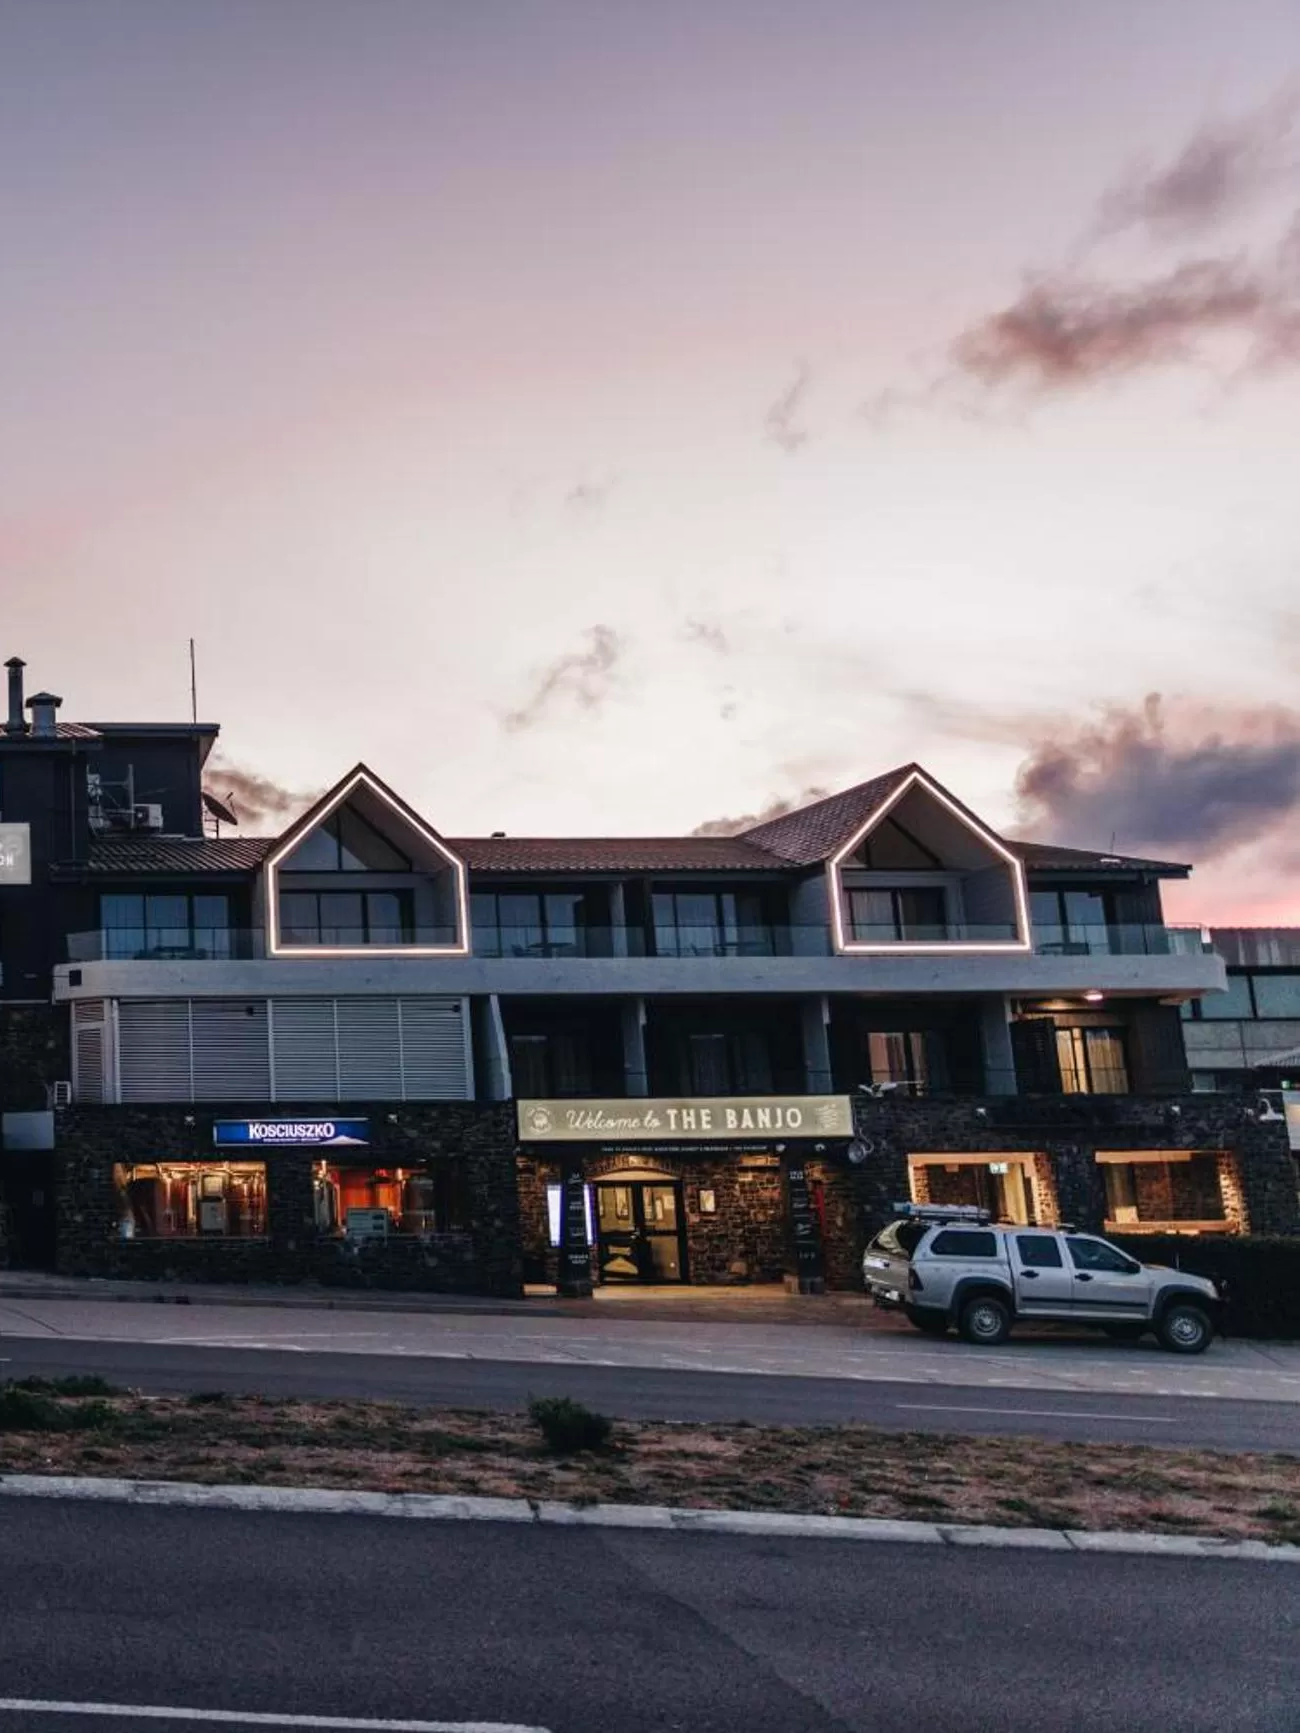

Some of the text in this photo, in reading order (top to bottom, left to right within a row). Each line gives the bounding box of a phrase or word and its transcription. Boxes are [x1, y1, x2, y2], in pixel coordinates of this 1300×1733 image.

[566, 1110, 641, 1130] Welcome
[643, 1110, 662, 1129] to
[666, 1108, 712, 1131] THE
[725, 1107, 802, 1129] BANJO
[248, 1122, 336, 1140] KOSCIUSZKO
